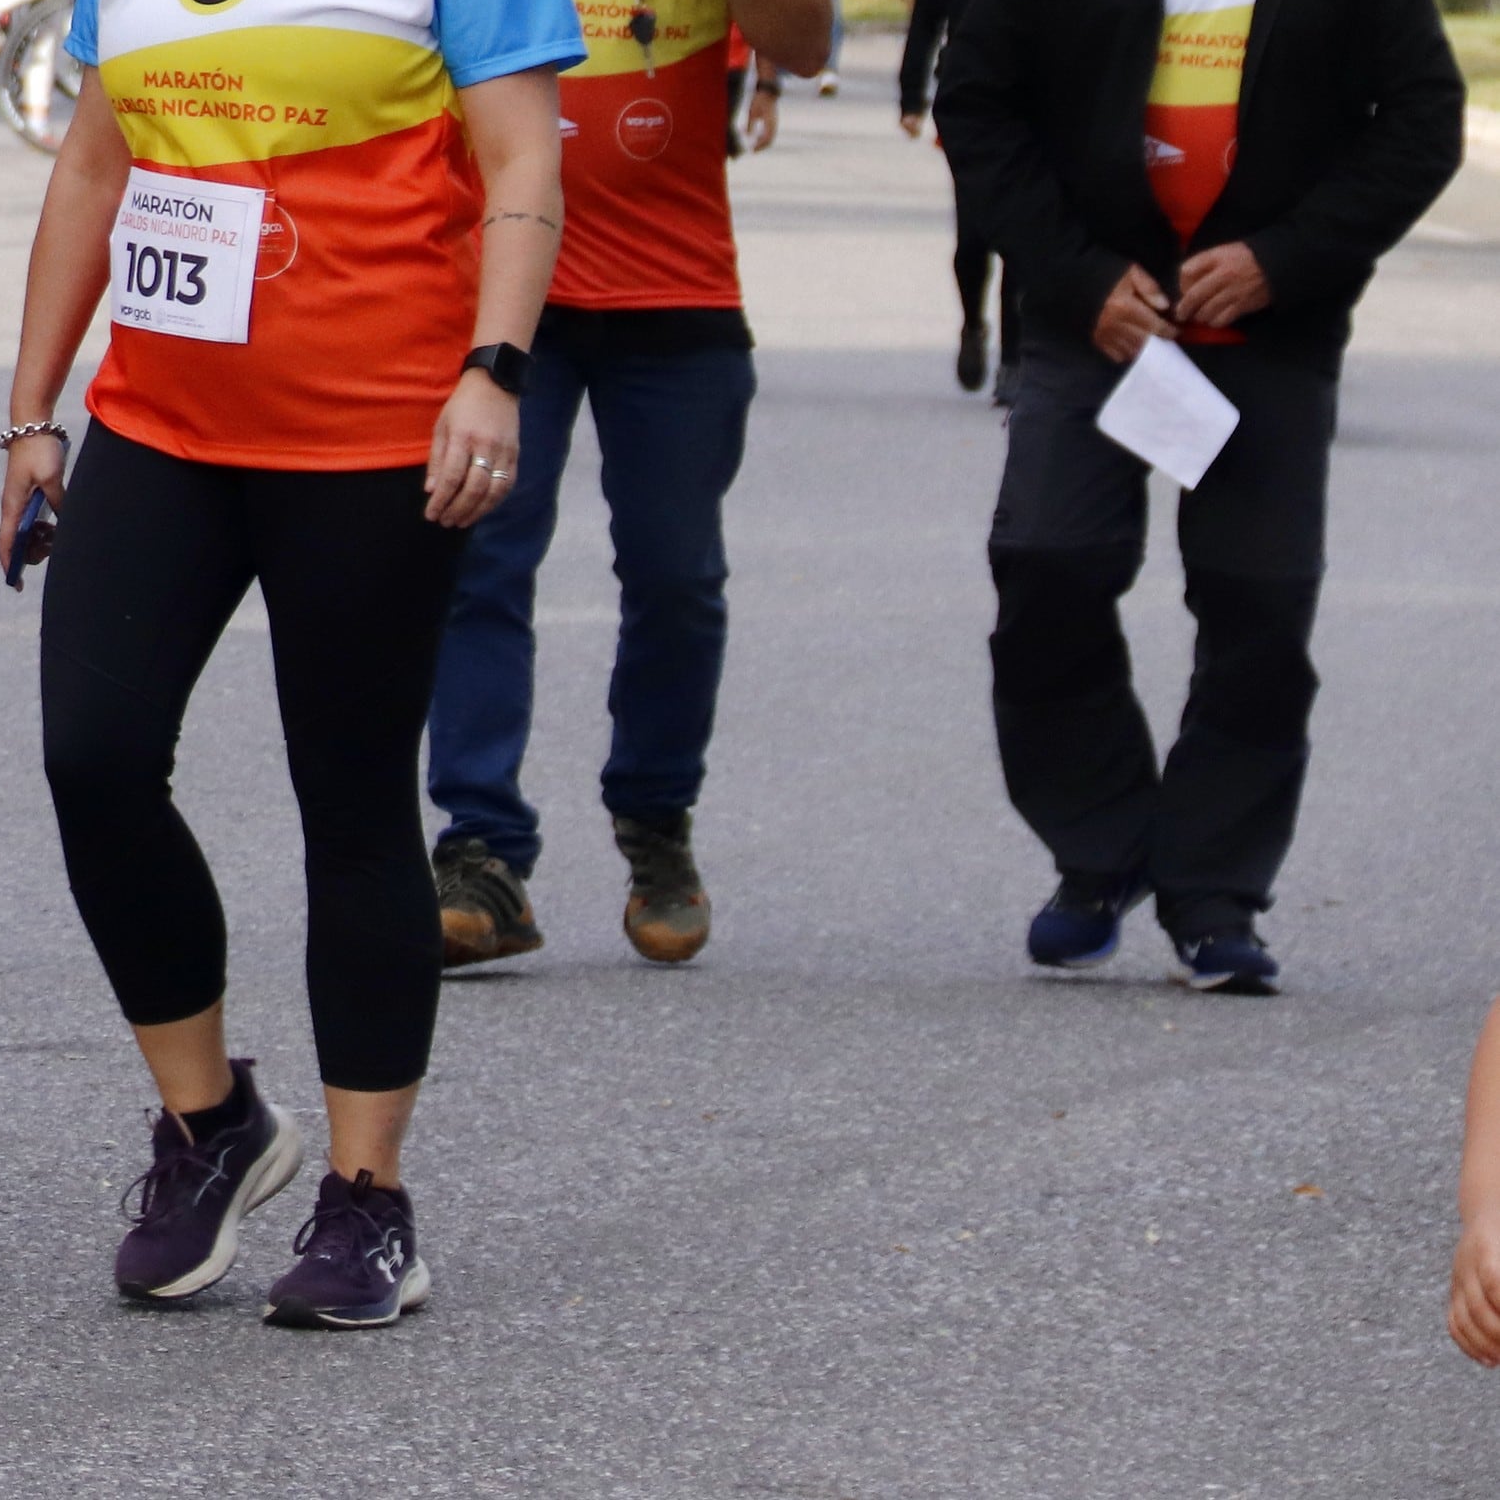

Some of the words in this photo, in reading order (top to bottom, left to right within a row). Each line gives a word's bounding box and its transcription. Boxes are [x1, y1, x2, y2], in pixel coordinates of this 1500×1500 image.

[143, 67, 244, 91] MARATÓN
[161, 99, 276, 122] NICANDRO
[284, 106, 329, 126] PAZ
[131, 190, 214, 223] MARATÓN
[120, 211, 148, 232] CARLOS
[151, 218, 208, 242] NICANDRO
[211, 229, 238, 247] PAZ
[126, 242, 209, 306] 1013
